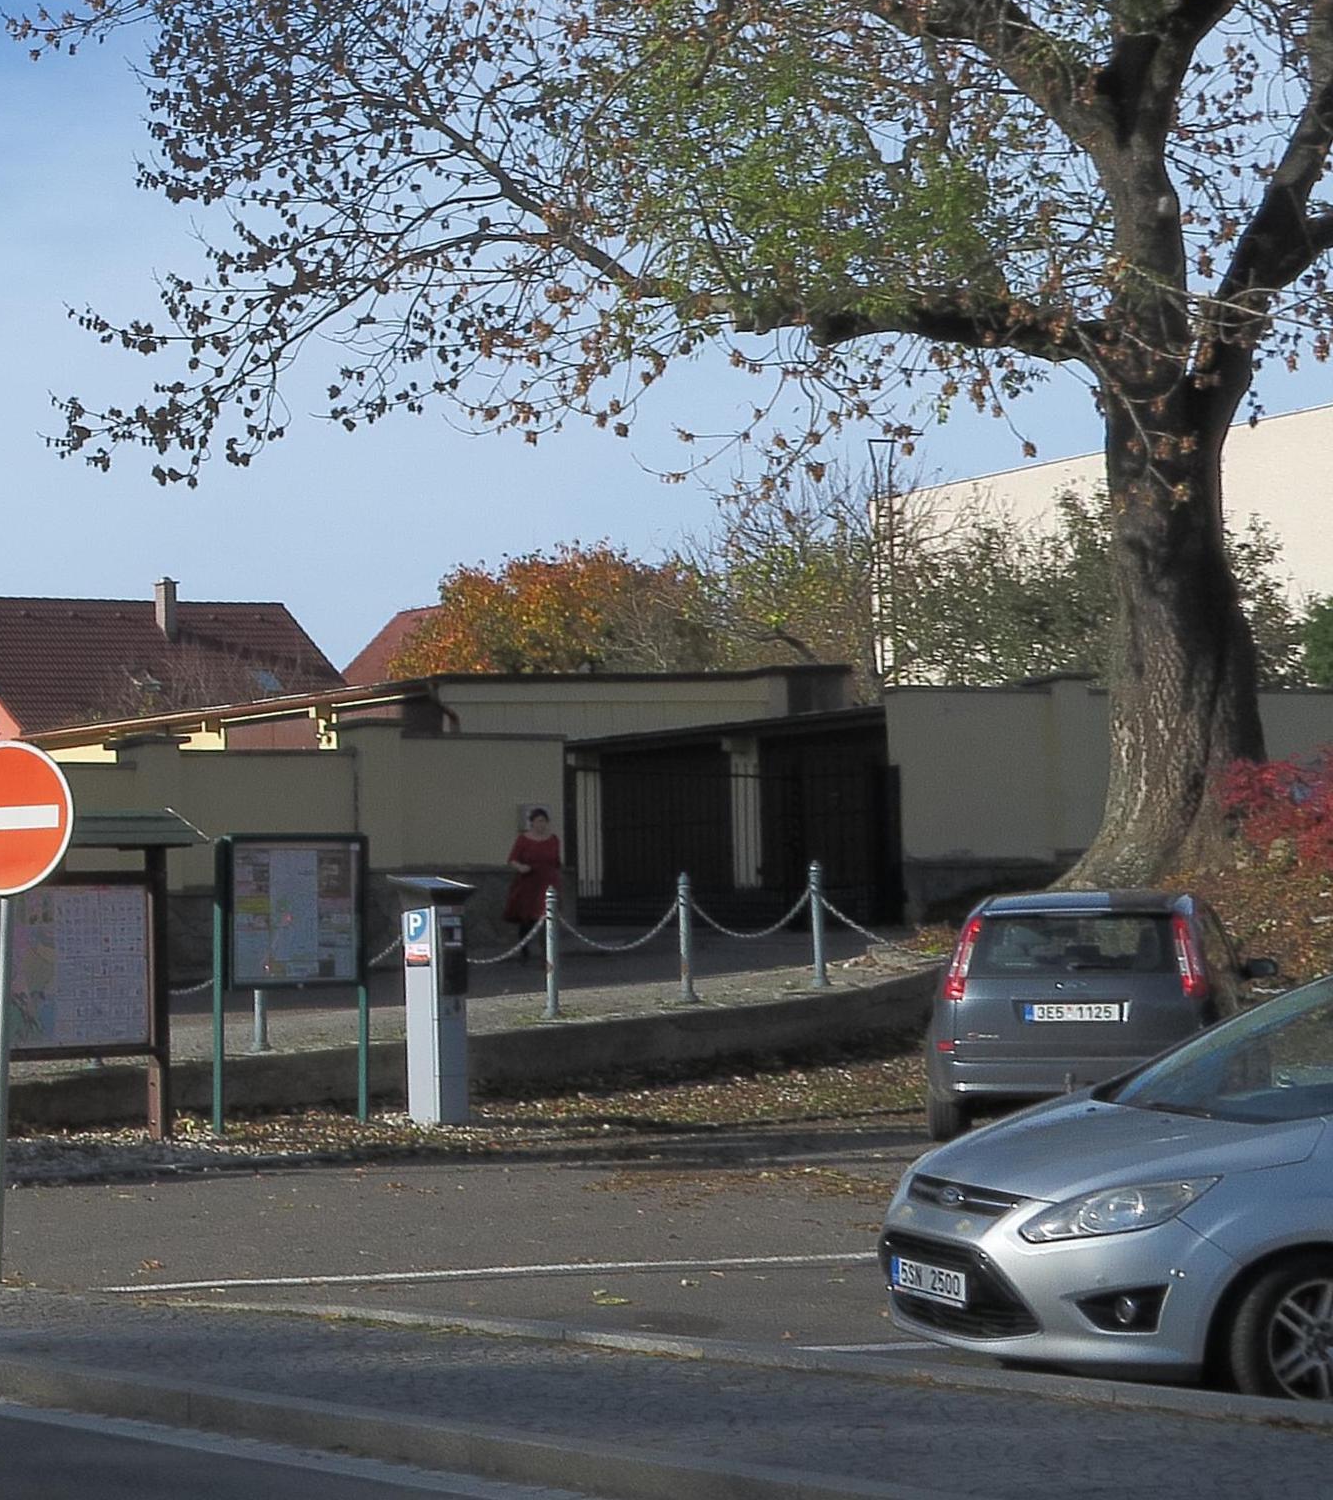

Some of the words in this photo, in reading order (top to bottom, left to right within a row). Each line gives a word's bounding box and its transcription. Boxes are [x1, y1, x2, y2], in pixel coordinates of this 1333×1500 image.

[408, 913, 423, 936] P
[1037, 1006, 1064, 1019] 3E5
[1077, 1006, 1113, 1019] 1125
[930, 1268, 960, 1296] 2500
